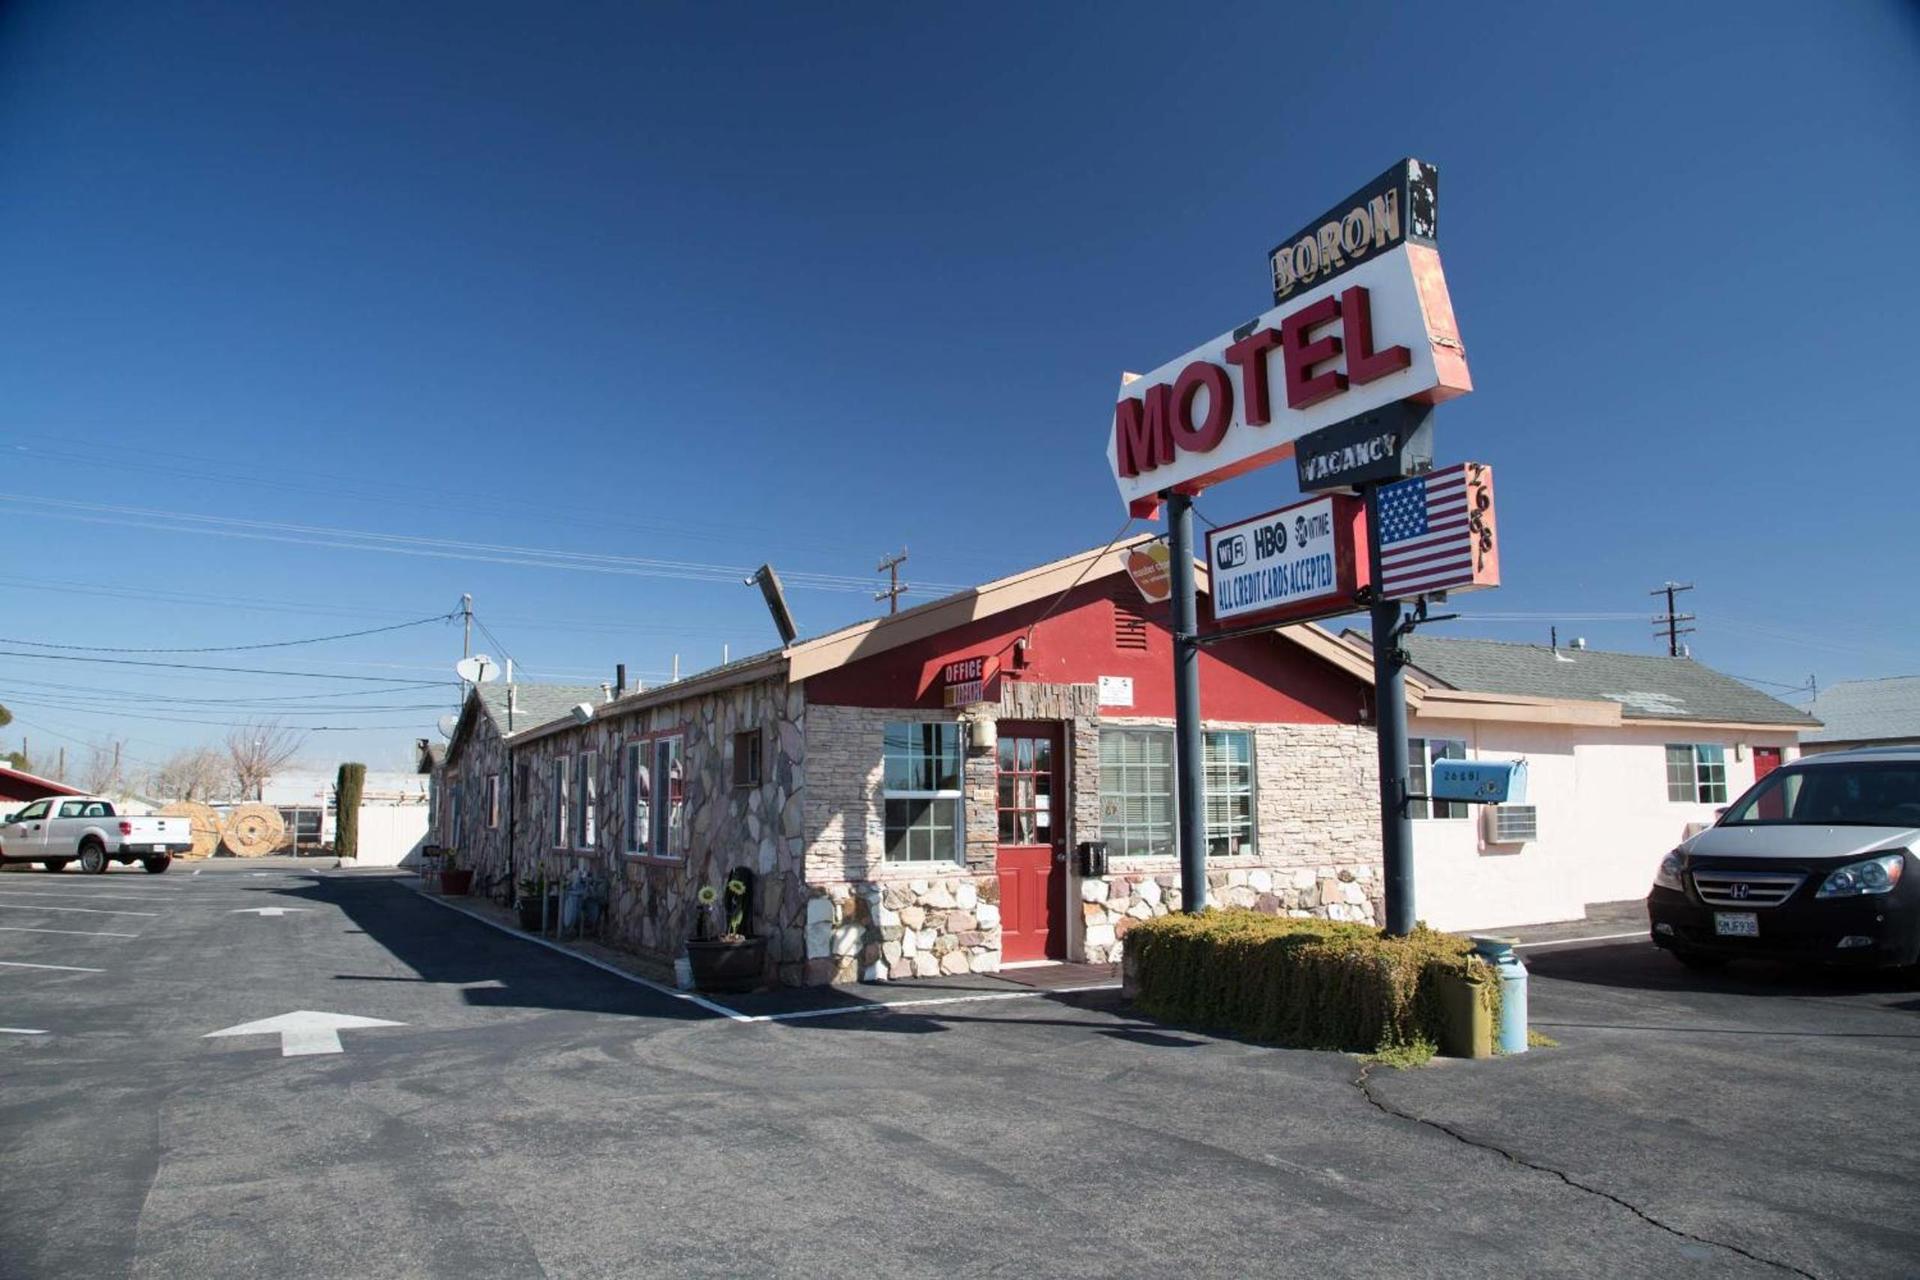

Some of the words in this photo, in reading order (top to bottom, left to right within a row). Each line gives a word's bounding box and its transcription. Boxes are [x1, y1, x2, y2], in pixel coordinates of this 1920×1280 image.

[1271, 187, 1400, 298] BORON
[1115, 285, 1411, 478] MOTEL
[1301, 432, 1397, 481] VACANCY
[1254, 521, 1288, 560] HBO
[1219, 579, 1233, 611] ALL
[1234, 571, 1261, 608] CREDIT
[1262, 563, 1288, 601] CARDS
[1290, 553, 1332, 594] ACCEPTED
[945, 659, 982, 682] OFFICE
